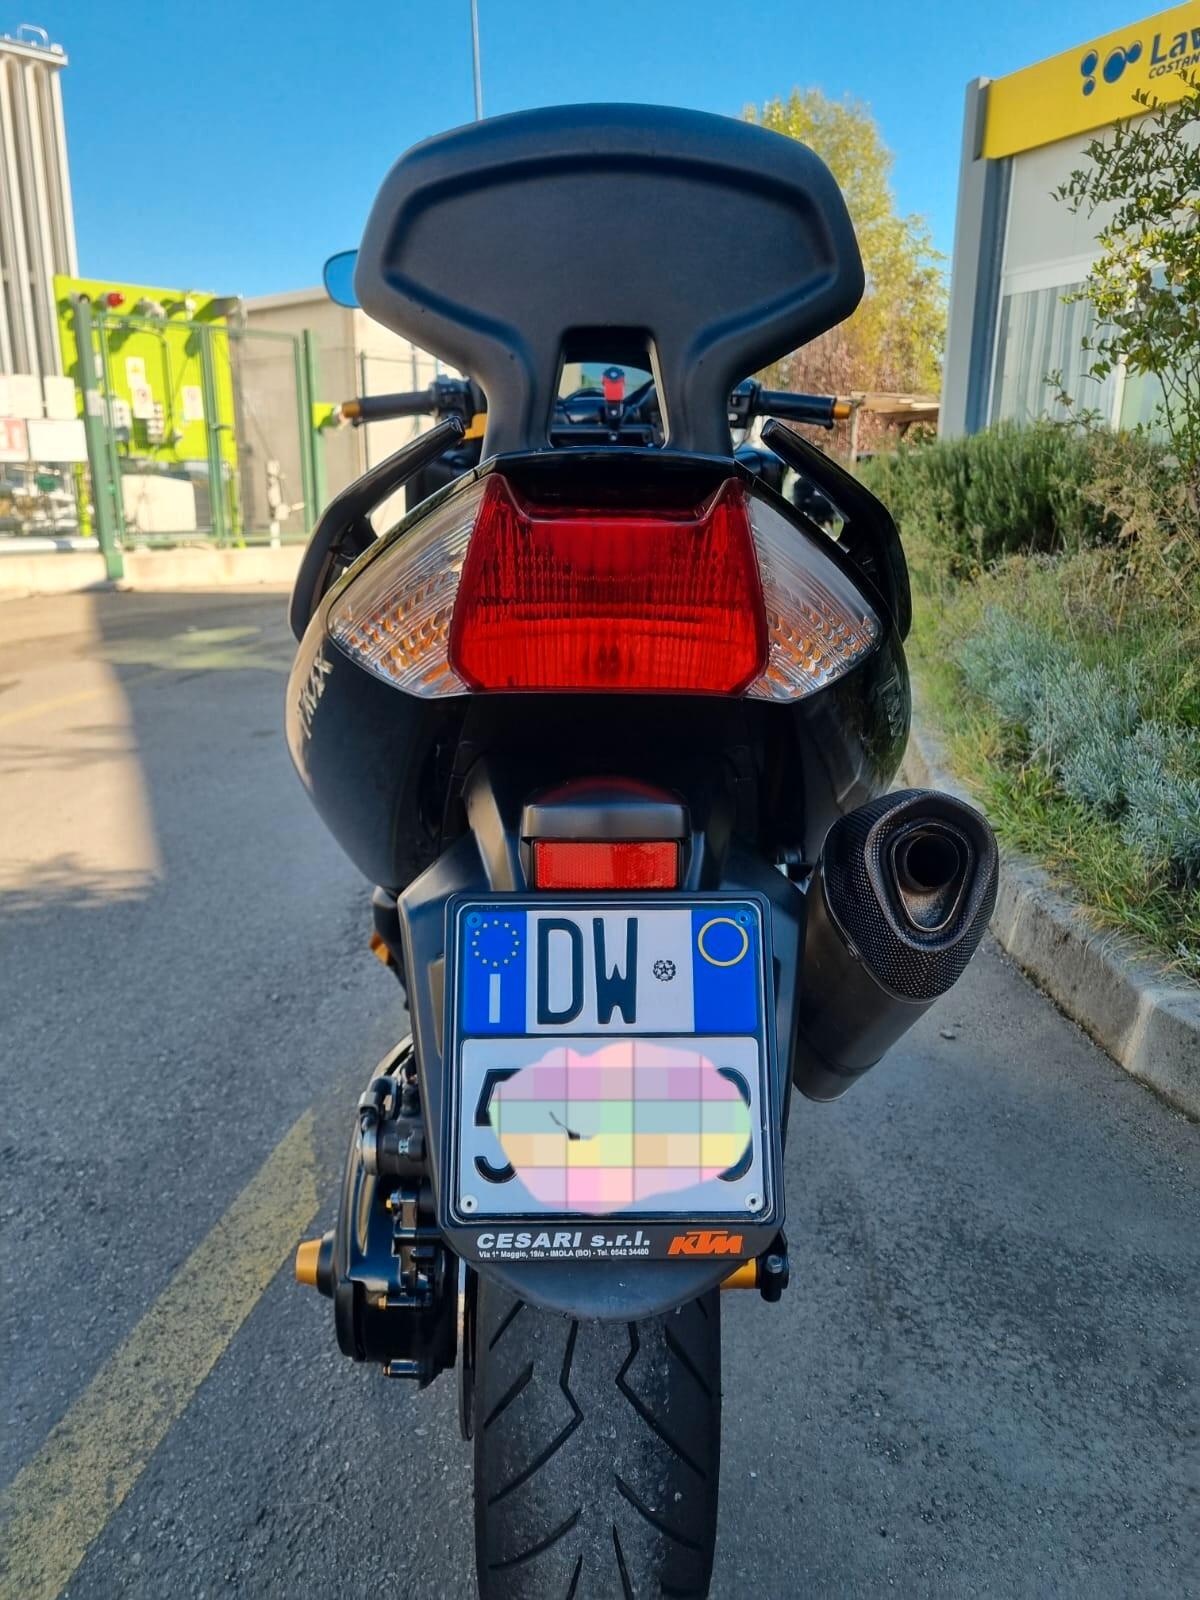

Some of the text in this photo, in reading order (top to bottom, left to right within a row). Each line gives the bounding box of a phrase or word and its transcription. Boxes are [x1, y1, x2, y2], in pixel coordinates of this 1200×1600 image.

[537, 917, 638, 1025] DW
[476, 1230, 650, 1249] CESARI s.r.l.
[668, 1230, 743, 1255] KTM
[550, 1249, 574, 1257] IMOLA
